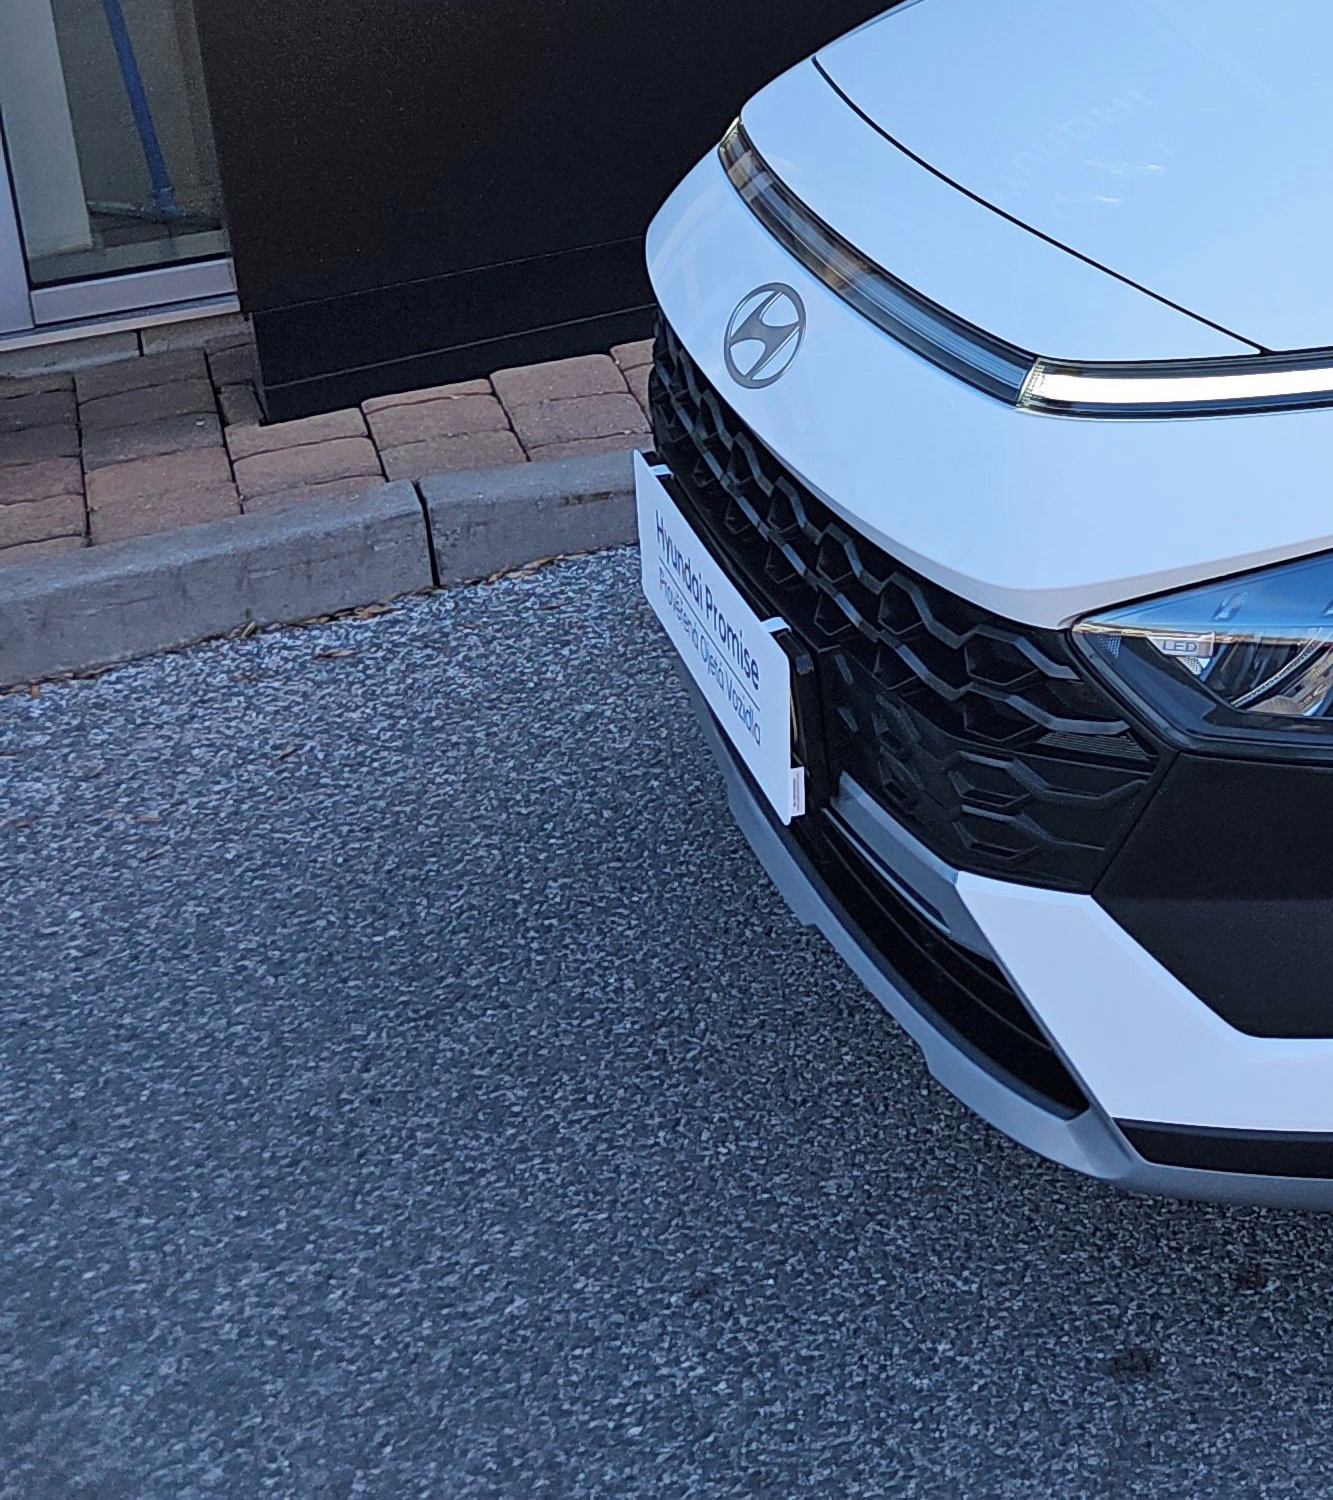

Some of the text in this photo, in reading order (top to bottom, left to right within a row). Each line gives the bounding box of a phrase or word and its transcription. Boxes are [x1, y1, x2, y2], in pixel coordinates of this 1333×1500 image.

[655, 508, 761, 691] Hyundai Promise
[1162, 640, 1198, 653] LED
[724, 670, 762, 748] Vozidla
